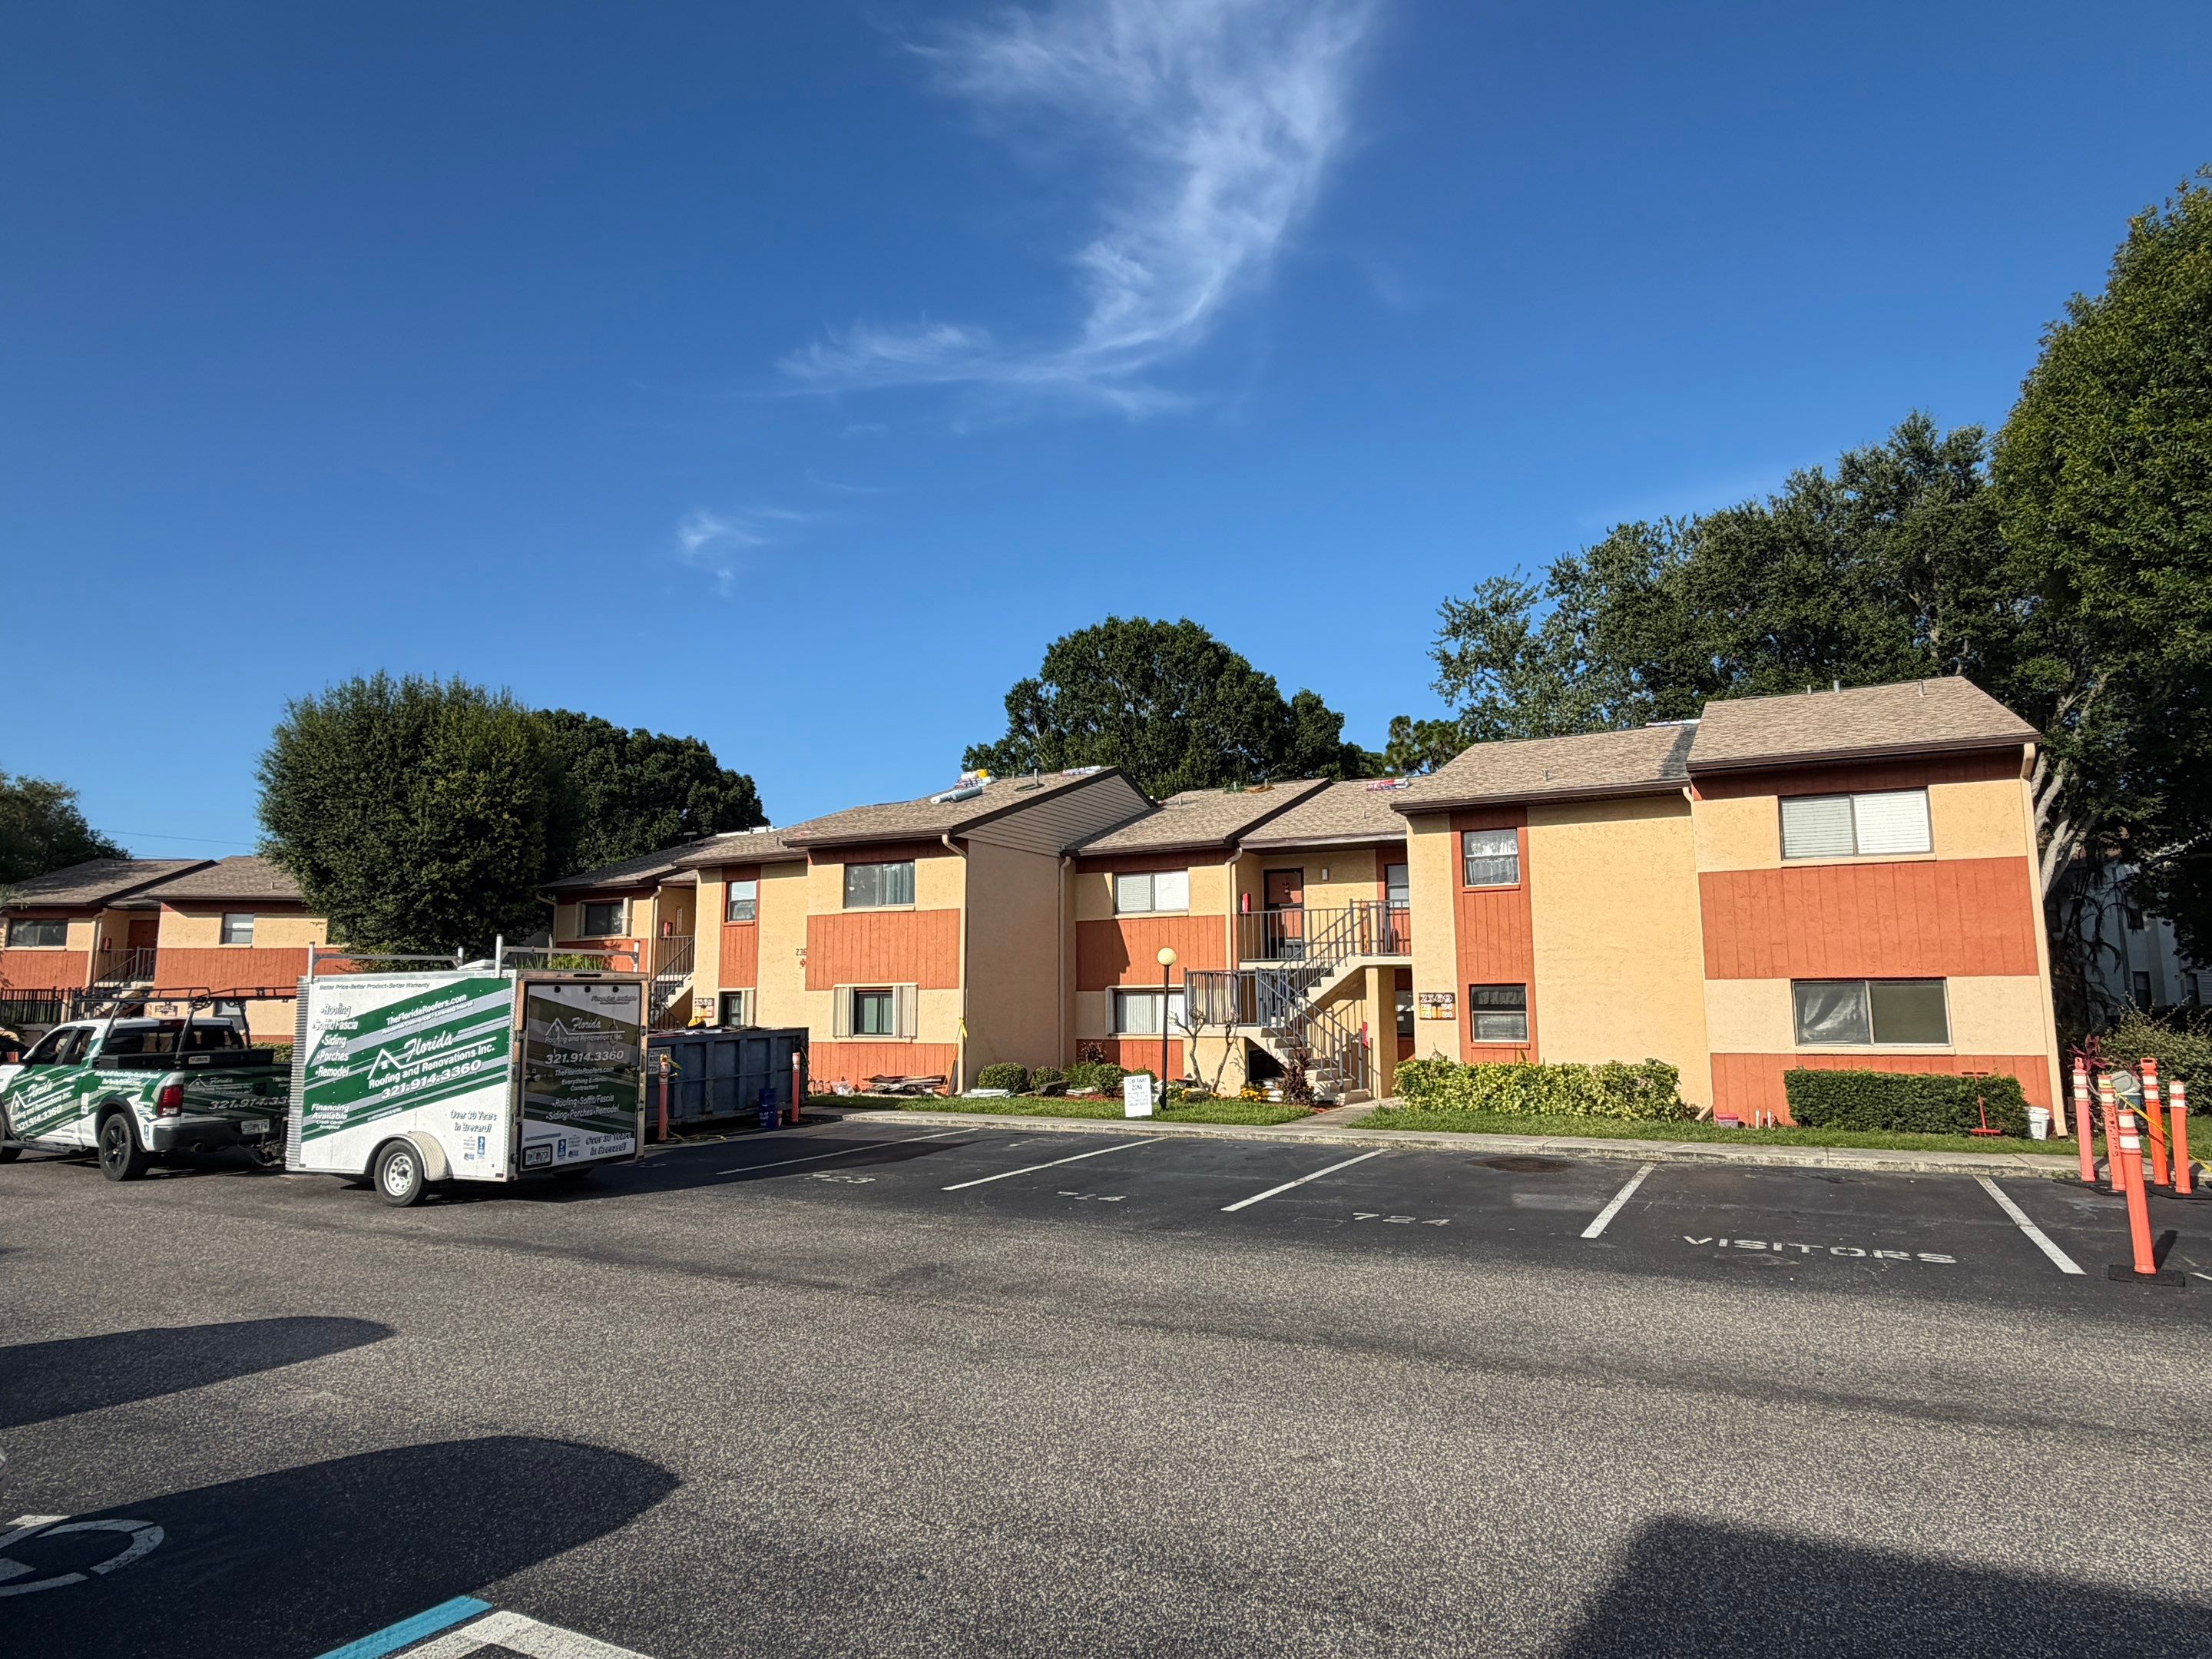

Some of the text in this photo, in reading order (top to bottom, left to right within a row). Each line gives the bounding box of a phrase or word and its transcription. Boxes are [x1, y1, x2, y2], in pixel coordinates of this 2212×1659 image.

[323, 1002, 352, 1018] Roofing
[386, 994, 467, 1026] TheFloridaRoofers.com
[571, 1016, 601, 1031] Florida
[323, 1033, 347, 1048] Siding
[403, 1030, 454, 1062] Florida
[319, 1050, 349, 1061] Porches
[545, 1050, 624, 1065] 321.914.3360
[318, 1065, 350, 1078] Remodel
[369, 1043, 495, 1090] Roofing and Renovations Inc.
[381, 1059, 482, 1101] 321.914.3360
[310, 1104, 350, 1113] Financing
[311, 1111, 348, 1120] Available
[450, 1109, 467, 1120] Over
[478, 1111, 498, 1121] Years
[15, 1104, 63, 1132] 321.914.3360
[1353, 1212, 1451, 1227] 724
[1683, 1235, 1957, 1263] VISITORS
